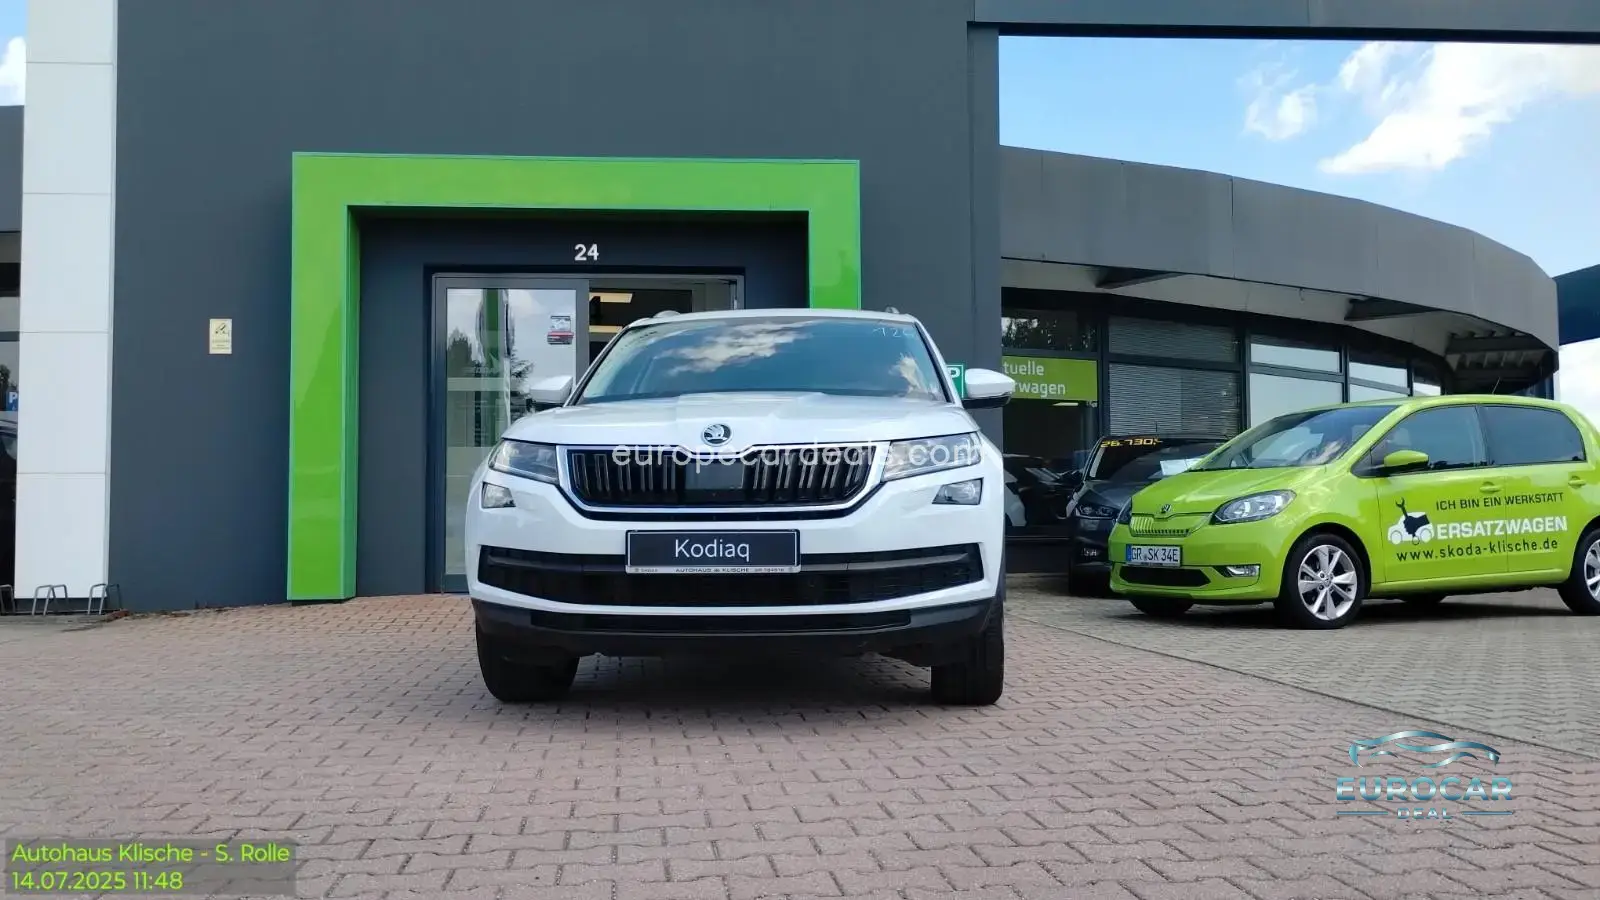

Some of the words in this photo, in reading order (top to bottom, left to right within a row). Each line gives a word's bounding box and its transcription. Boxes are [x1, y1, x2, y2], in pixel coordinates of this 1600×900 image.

[574, 243, 600, 261] 24
[1003, 360, 1045, 376] tuelle
[8, 391, 18, 404] P
[1013, 381, 1066, 397] rwagen
[1436, 500, 1456, 511] ICH
[1460, 498, 1480, 509] BIN
[1483, 496, 1502, 507] EIN
[1504, 492, 1563, 505] WERKSTATT
[1436, 515, 1568, 540] ERSATZWAGEN
[675, 538, 750, 562] Kodiaq
[1131, 547, 1142, 561] GR
[1147, 548, 1159, 561] SK
[1161, 548, 1179, 562] 34E
[1397, 537, 1558, 561] www.skoda-klische.de
